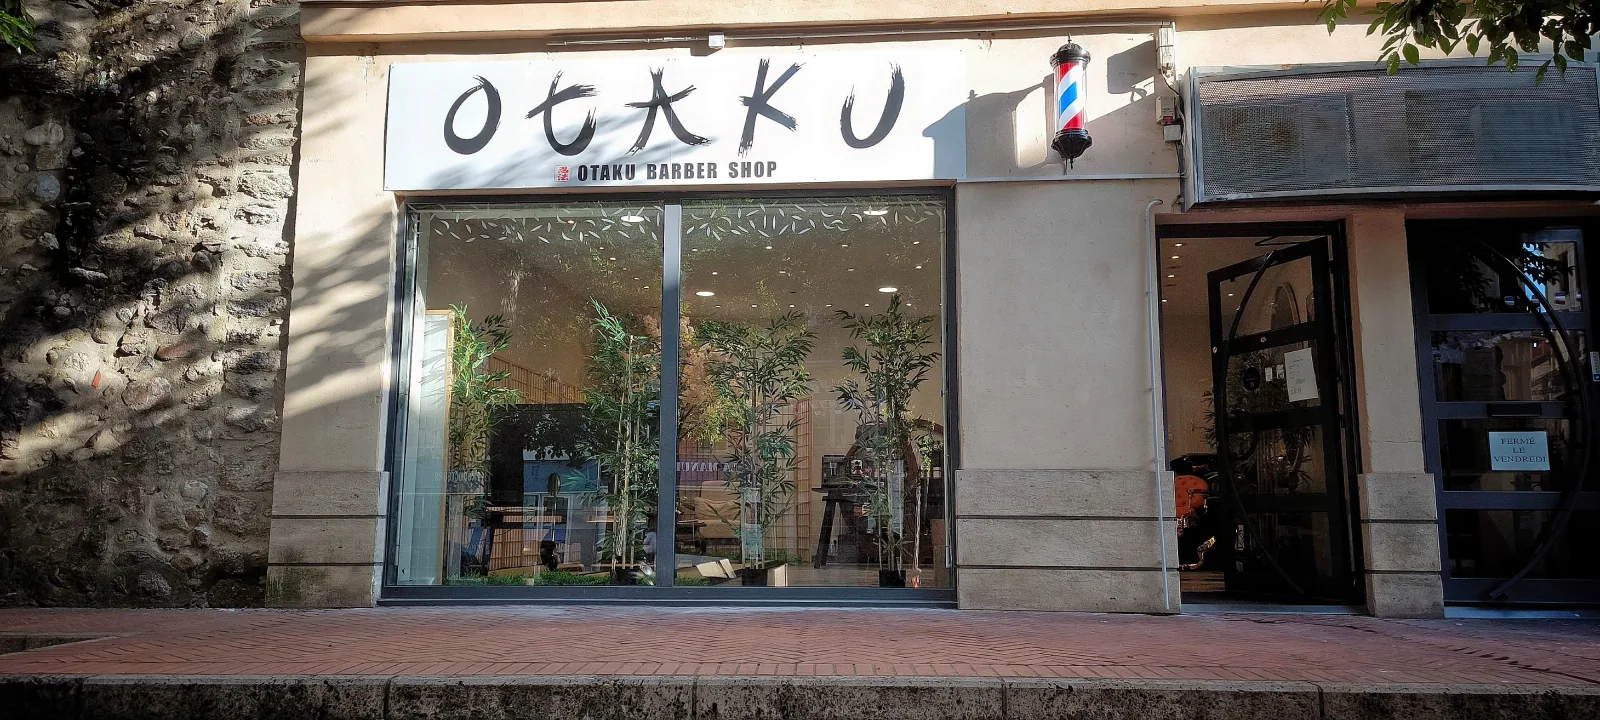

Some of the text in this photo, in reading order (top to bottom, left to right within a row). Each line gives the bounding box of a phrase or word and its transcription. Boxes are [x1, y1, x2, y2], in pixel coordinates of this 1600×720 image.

[577, 161, 778, 181] OTAKU BARBER SHOP
[1501, 437, 1536, 445] FERMÉ
